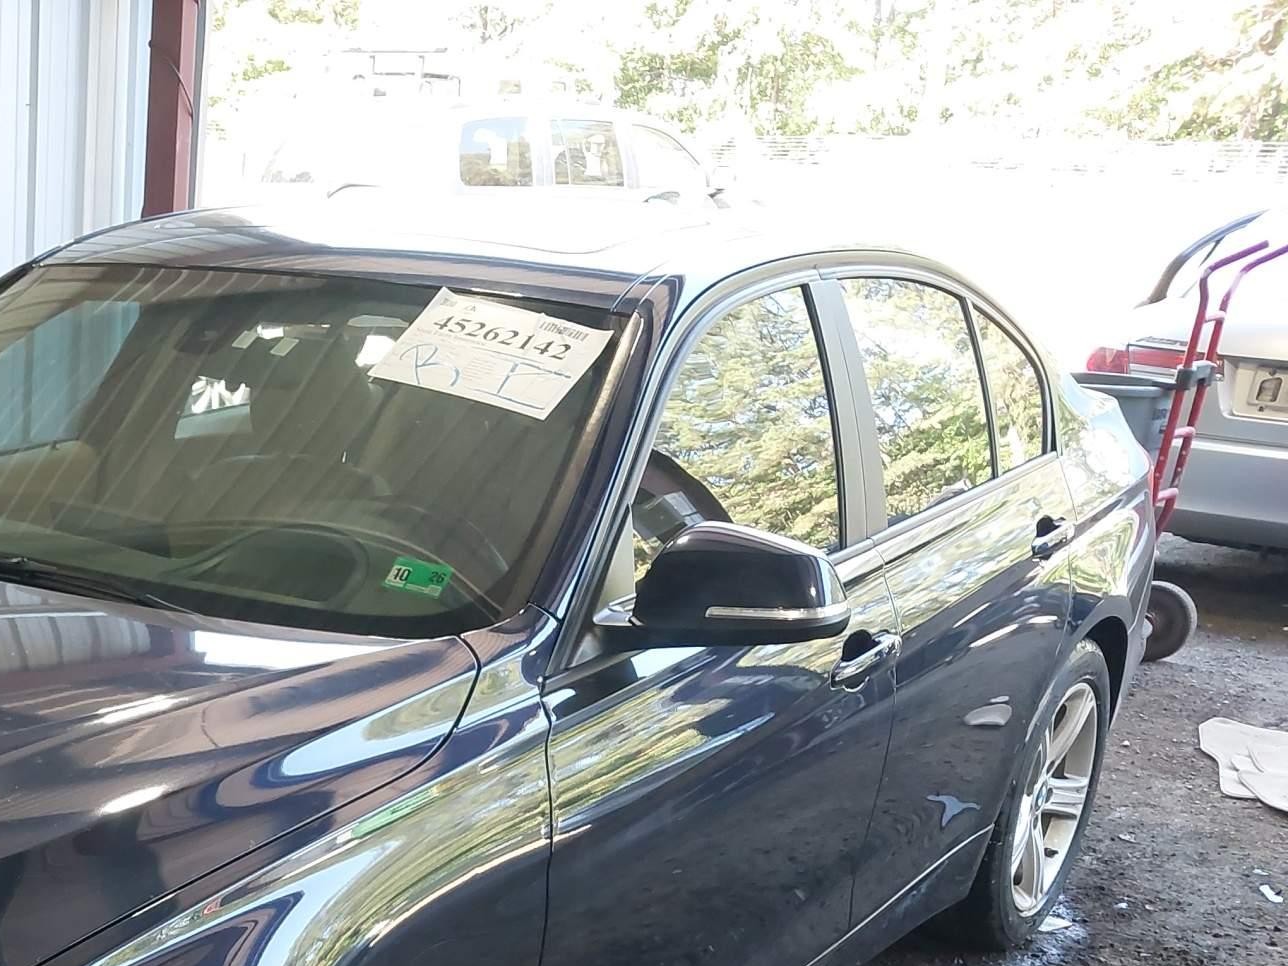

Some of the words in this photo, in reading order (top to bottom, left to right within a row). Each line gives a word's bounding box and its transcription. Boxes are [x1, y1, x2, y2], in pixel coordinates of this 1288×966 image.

[434, 316, 572, 360] 45262142
[394, 567, 412, 582] 10
[429, 571, 446, 584] 26
